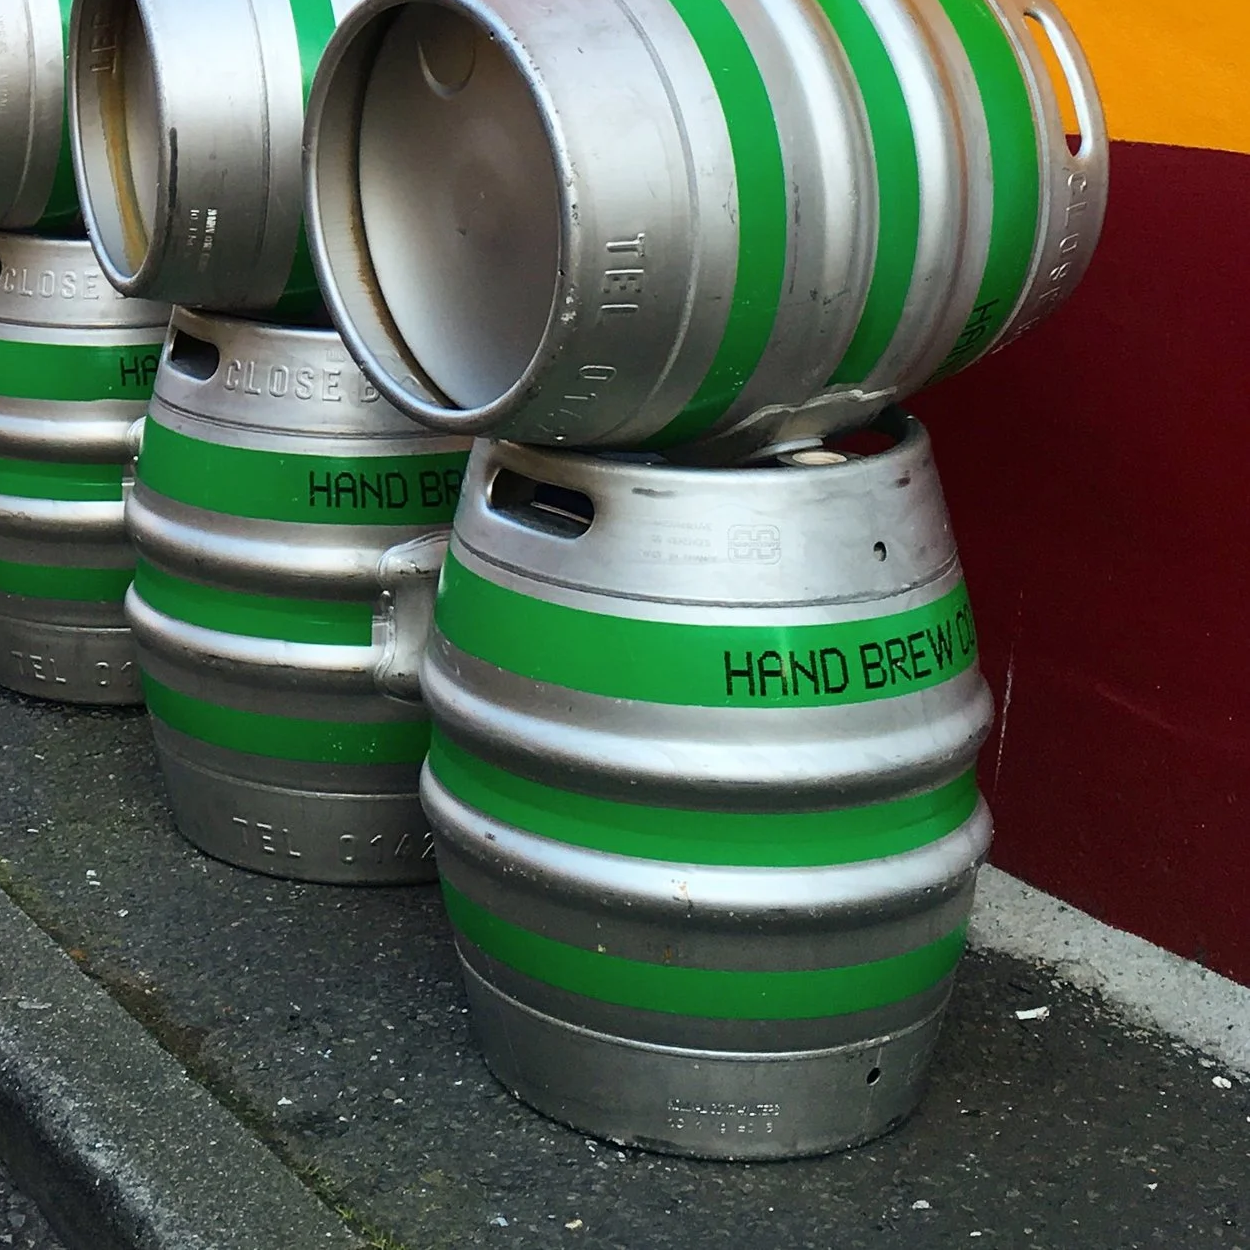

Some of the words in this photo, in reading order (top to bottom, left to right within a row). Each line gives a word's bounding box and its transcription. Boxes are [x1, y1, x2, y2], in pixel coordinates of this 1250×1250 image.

[2, 266, 100, 300] CLOSE
[223, 359, 342, 403] CLOSE
[309, 470, 409, 509] HAND
[723, 647, 849, 697] HAND
[859, 619, 953, 690] BREW
